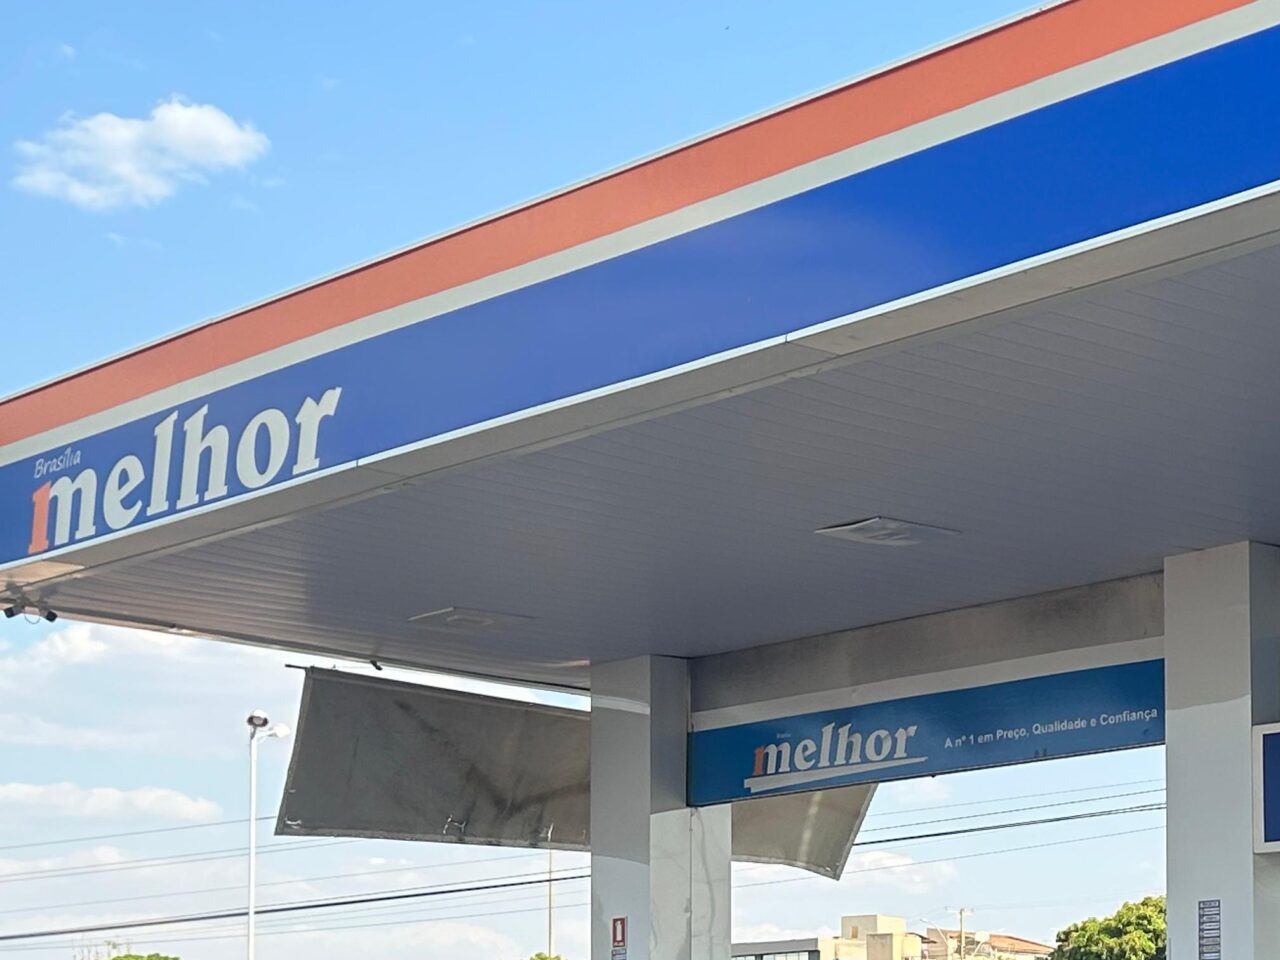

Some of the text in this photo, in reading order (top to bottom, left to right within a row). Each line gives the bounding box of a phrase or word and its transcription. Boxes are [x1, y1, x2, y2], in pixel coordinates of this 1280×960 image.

[28, 386, 343, 554] melhor
[33, 446, 82, 479] Brasília
[753, 722, 918, 776] melhor
[944, 737, 953, 749] A
[969, 734, 975, 745] 1
[977, 733, 994, 744] em
[996, 726, 1030, 740] Preço,
[1032, 718, 1087, 735] Qualidade
[1089, 719, 1097, 727] e
[1099, 708, 1158, 726] Confiança
